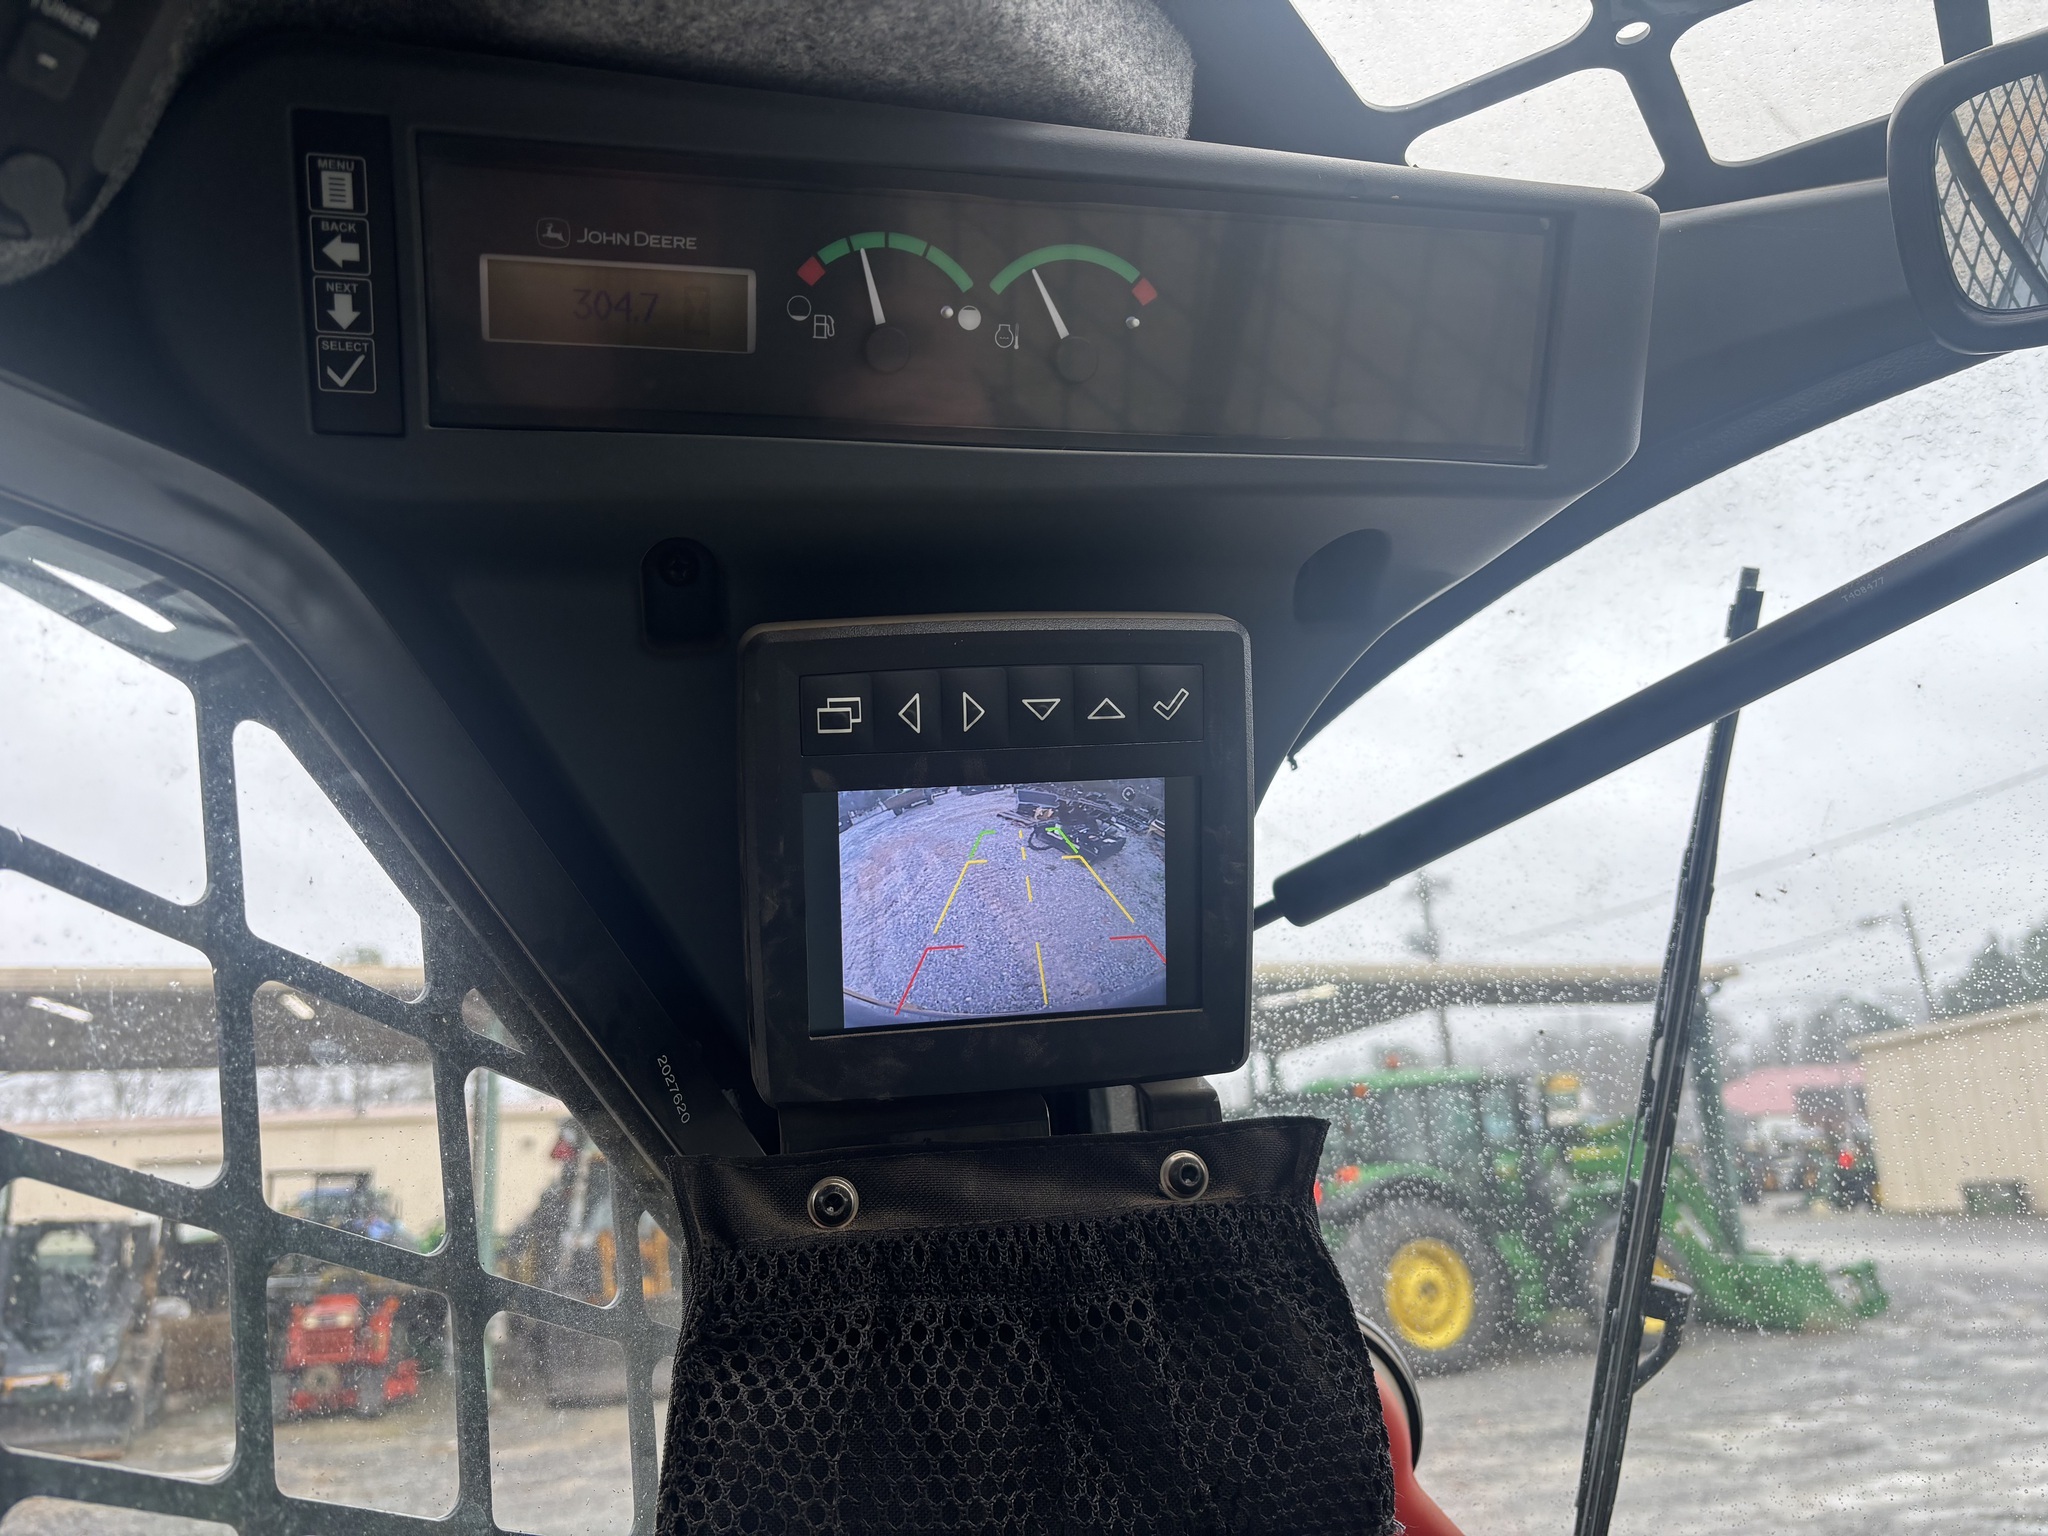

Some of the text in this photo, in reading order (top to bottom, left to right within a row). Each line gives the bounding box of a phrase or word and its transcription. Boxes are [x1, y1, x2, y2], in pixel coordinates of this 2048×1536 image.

[318, 158, 355, 172] MENU
[321, 220, 357, 233] BACK
[577, 227, 697, 250] JOHN DEERE
[325, 282, 358, 294] NEXT
[572, 288, 659, 323] 304.7
[321, 340, 369, 353] SELECT
[1840, 576, 1885, 603] T408477
[657, 1054, 690, 1124] 2027620
